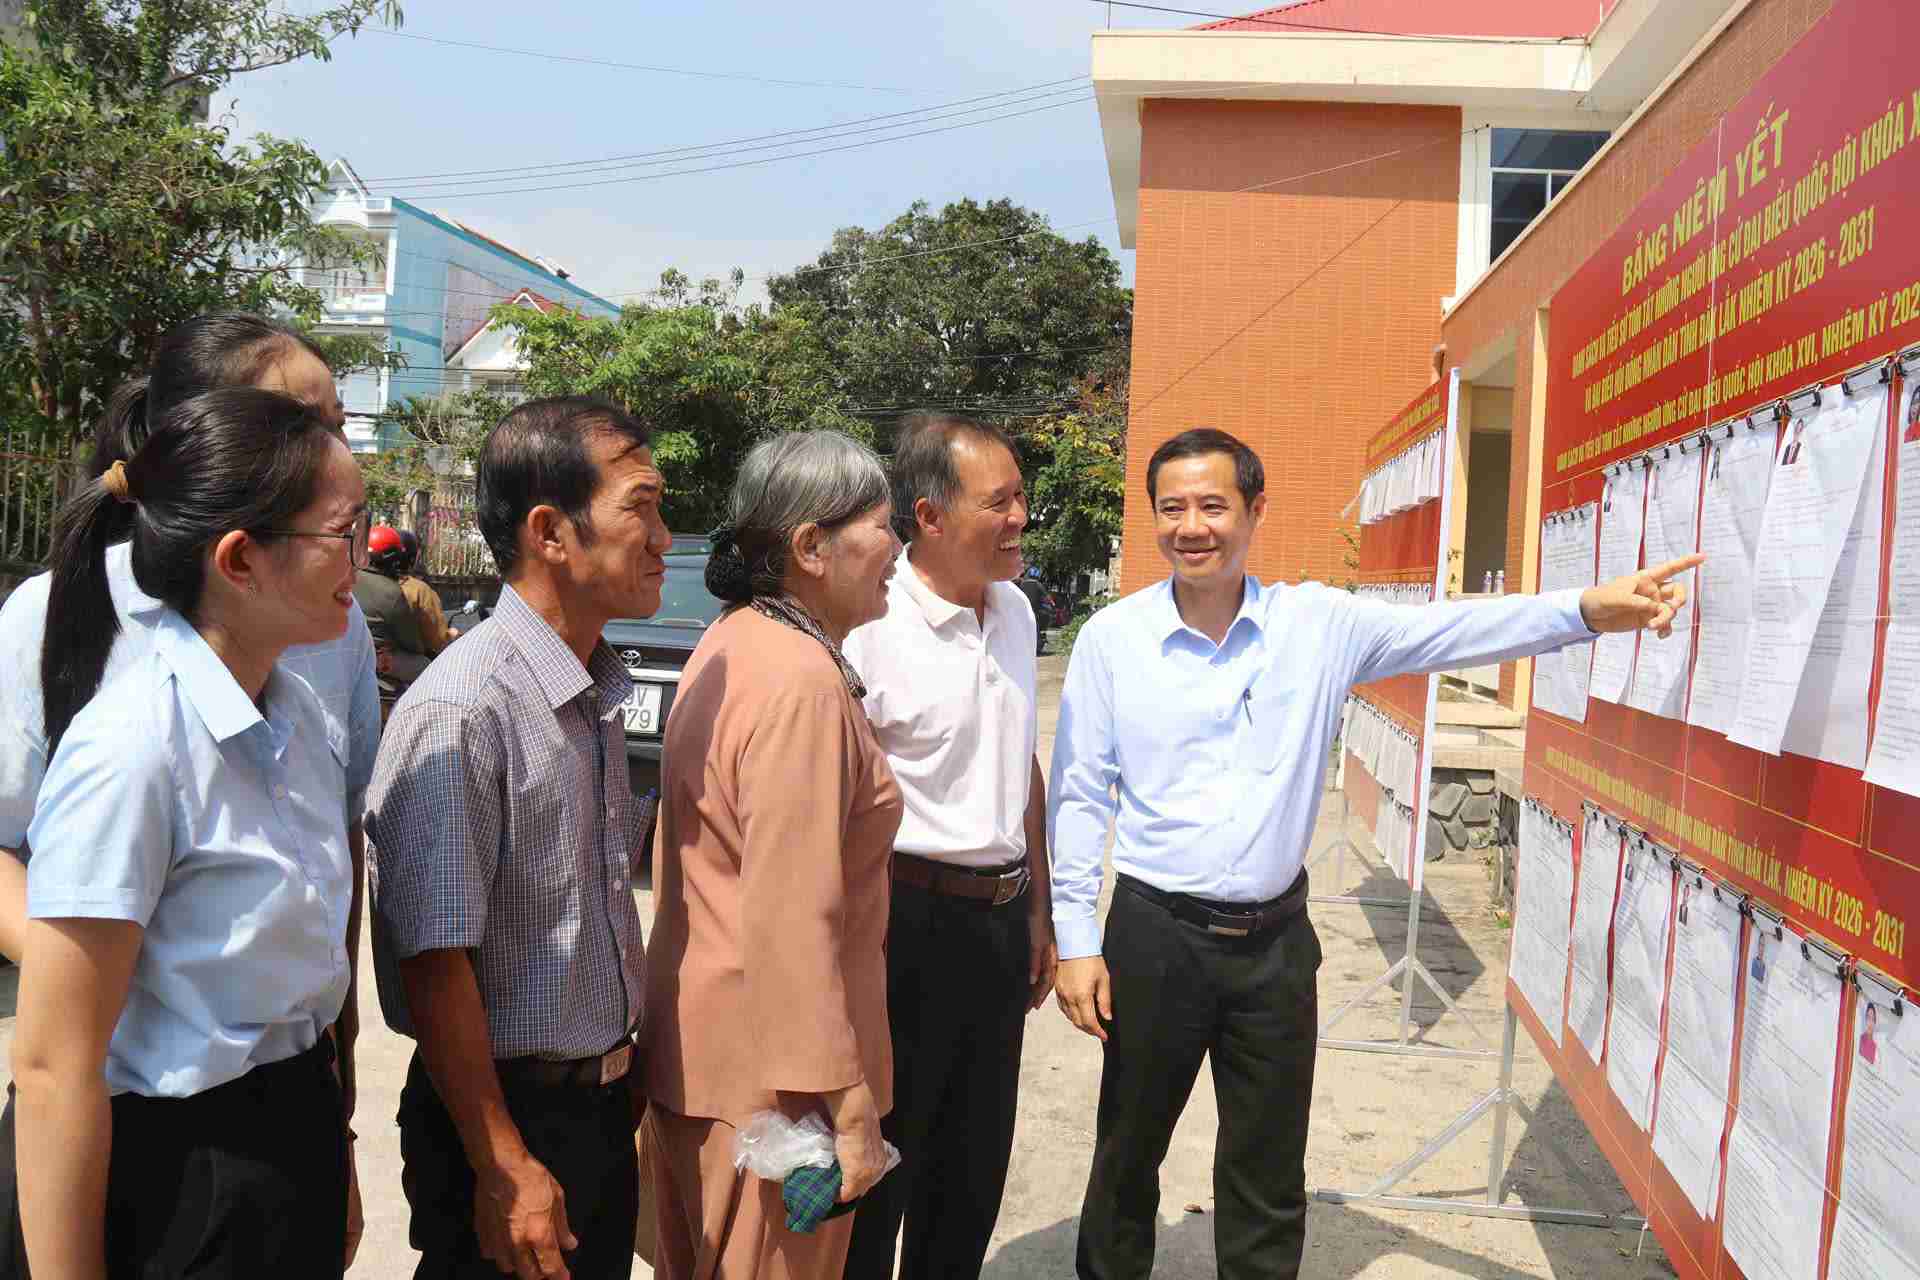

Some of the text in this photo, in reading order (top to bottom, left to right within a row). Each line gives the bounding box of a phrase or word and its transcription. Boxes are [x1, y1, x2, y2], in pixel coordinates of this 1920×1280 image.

[1622, 101, 1789, 296] BẢNG NIÊM YẾT
[1794, 150, 1828, 226] QUỐC
[1832, 133, 1856, 198] HỘI
[1739, 268, 1773, 325] NHIỆM
[1776, 250, 1791, 304] KỲ
[1793, 238, 1825, 294] 2026
[1839, 206, 1874, 267] 2031
[1822, 308, 1864, 358] NHIỆM
[1868, 291, 1888, 337] KỲ
[624, 709, 651, 728] 79
[1833, 892, 1863, 937] 2026
[1873, 910, 1904, 959] 2031
